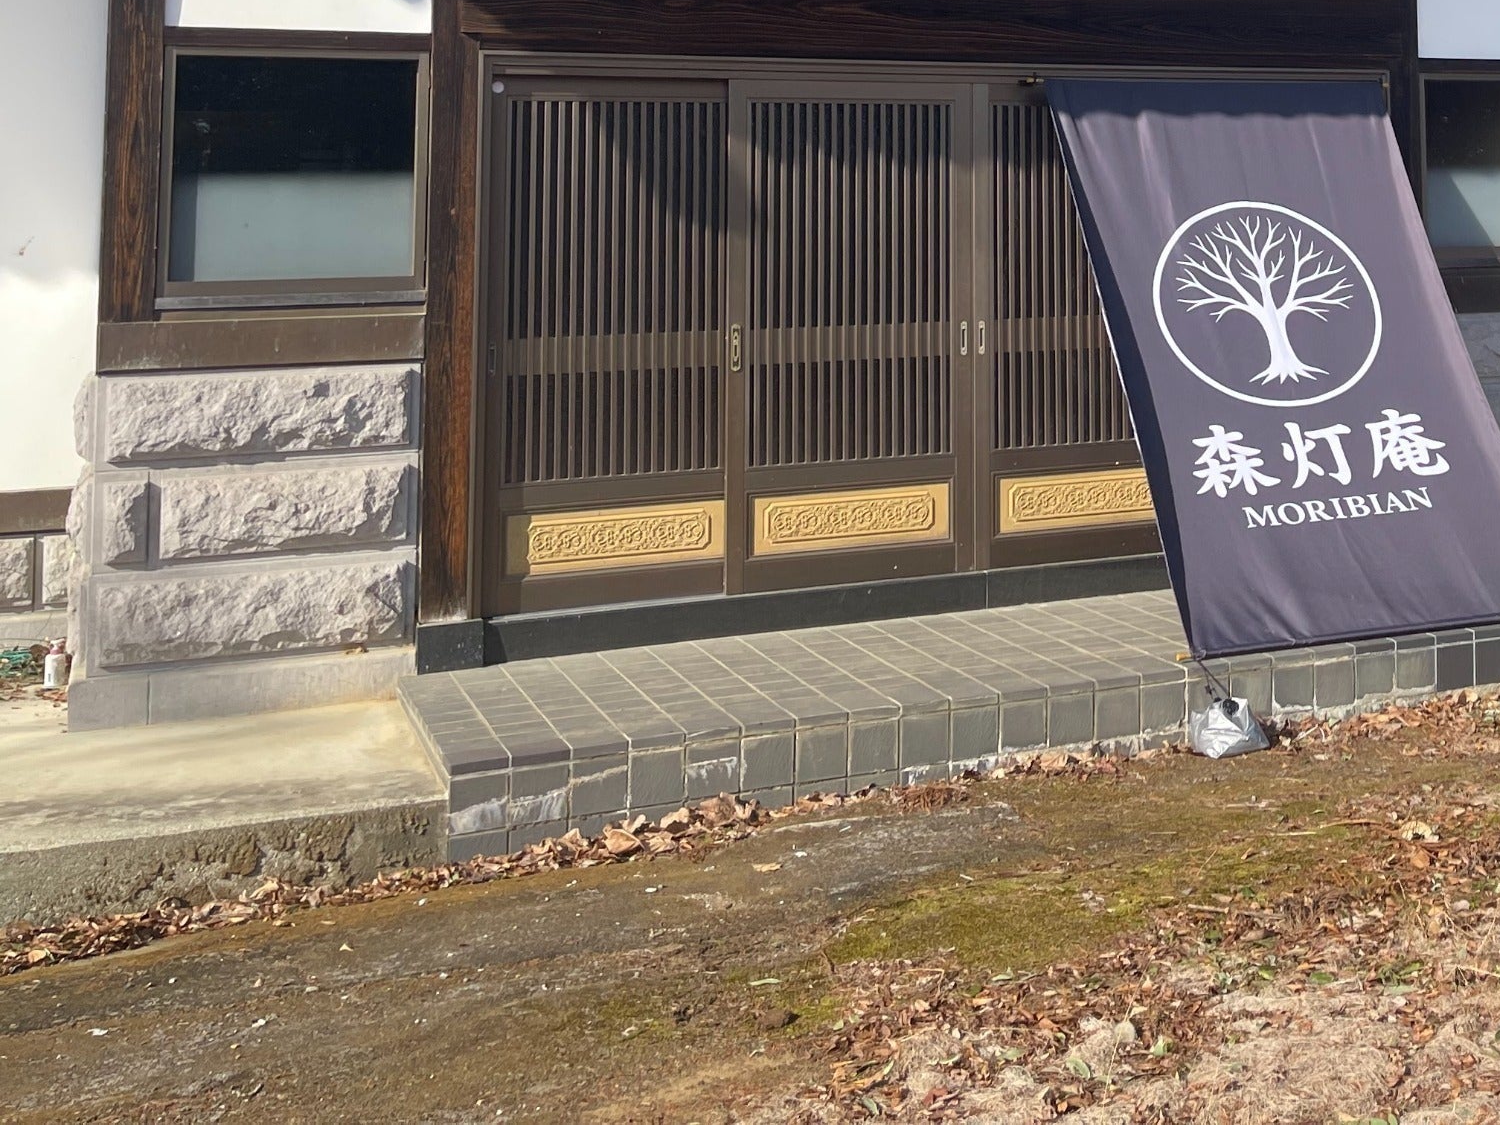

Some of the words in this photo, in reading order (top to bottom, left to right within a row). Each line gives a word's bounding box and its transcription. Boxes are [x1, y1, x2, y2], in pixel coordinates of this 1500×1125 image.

[1192, 408, 1450, 498] 森灯庵
[1242, 486, 1433, 529] MORIBIAN
